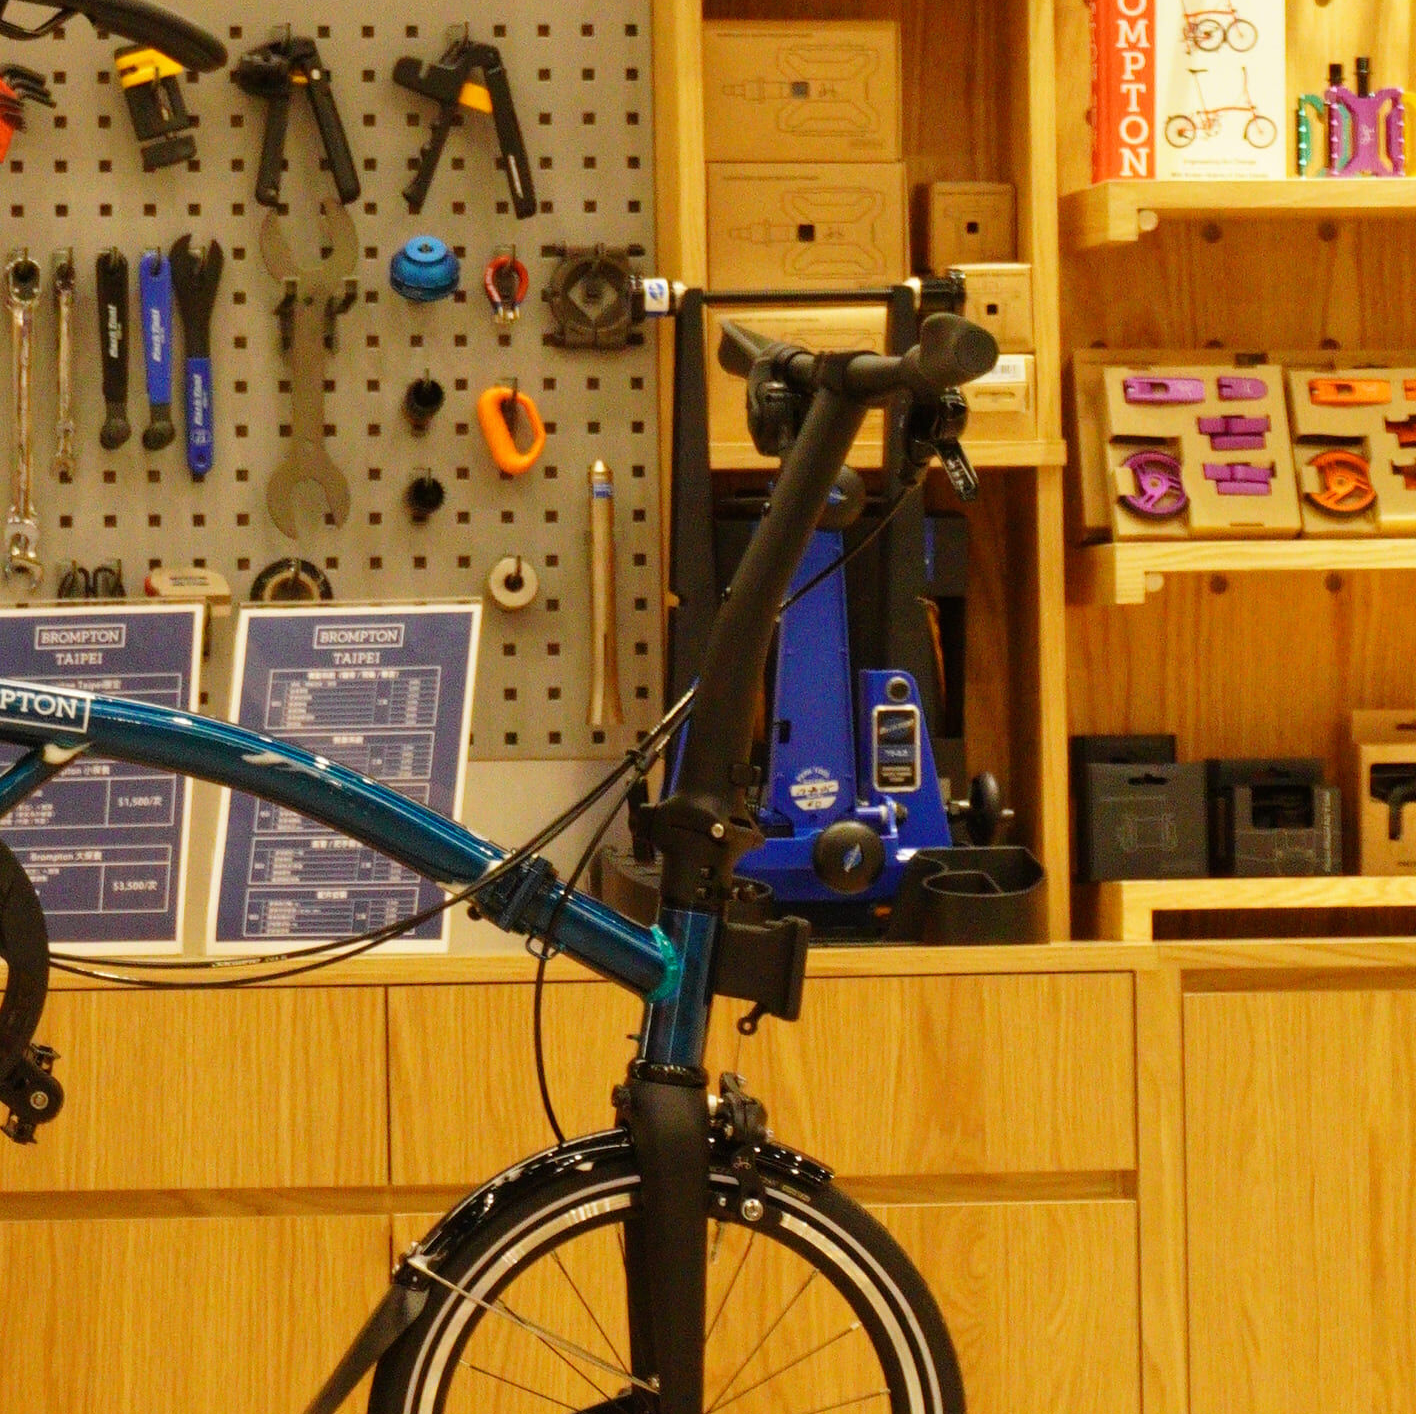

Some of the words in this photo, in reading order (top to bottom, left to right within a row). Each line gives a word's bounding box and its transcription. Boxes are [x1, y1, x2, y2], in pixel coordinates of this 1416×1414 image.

[41, 629, 119, 645] BROMPTON
[319, 628, 398, 644] BROMPTON
[55, 652, 103, 666] TAIPEI
[334, 651, 381, 665] TAIPEI
